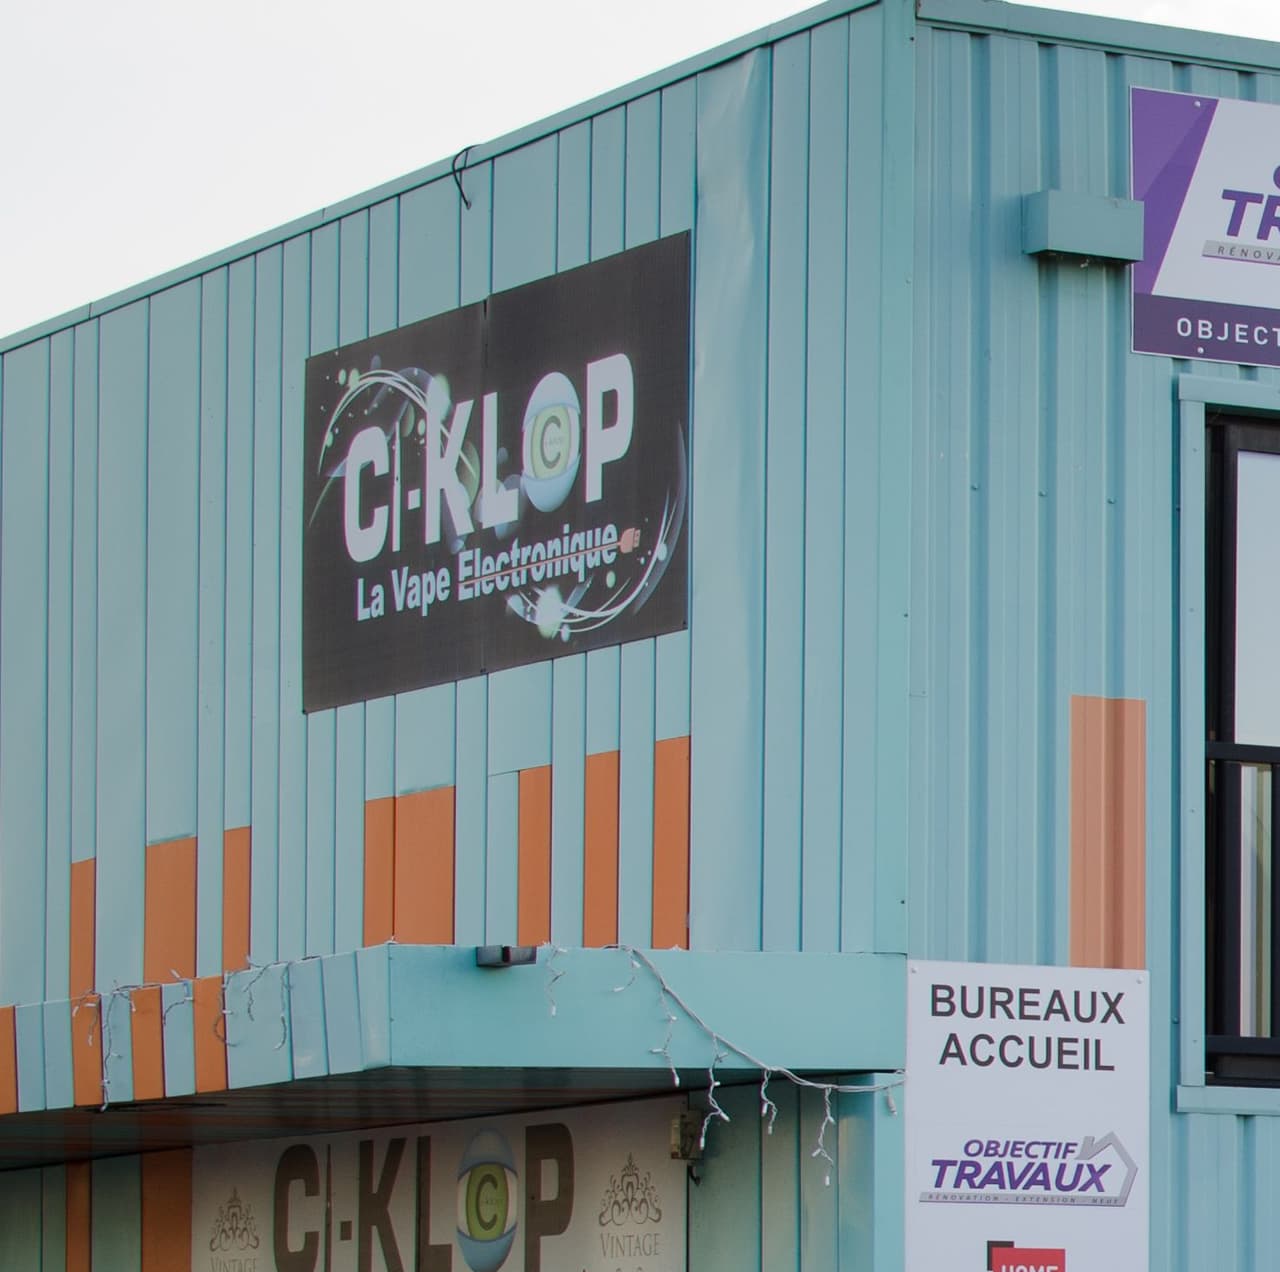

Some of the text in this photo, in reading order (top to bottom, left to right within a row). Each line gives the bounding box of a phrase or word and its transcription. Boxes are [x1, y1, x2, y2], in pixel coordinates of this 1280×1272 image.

[357, 523, 618, 621] La Vape Electronique
[930, 984, 1125, 1025] BUREAUX
[939, 1033, 1115, 1071] ACCUEIL
[963, 1139, 1078, 1159] OBJECTIF
[931, 1159, 1112, 1193] TRAVAUX
[1015, 1196, 1076, 1204] EXTENSION
